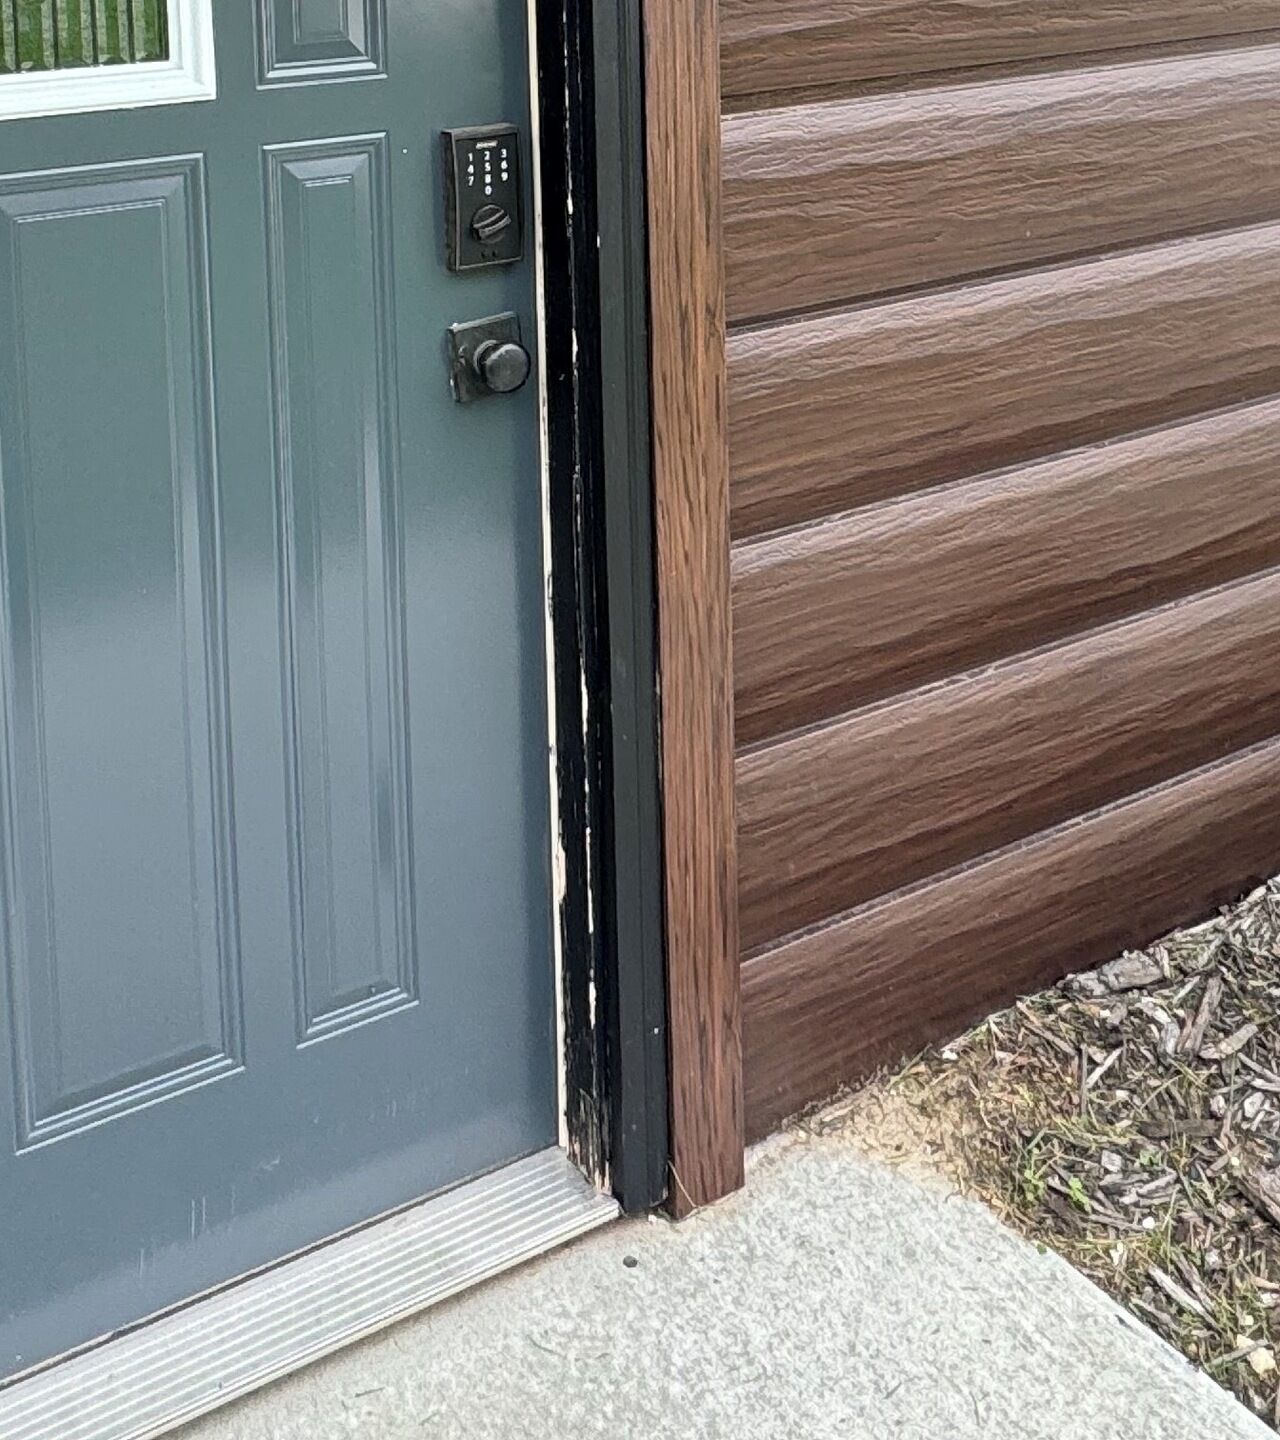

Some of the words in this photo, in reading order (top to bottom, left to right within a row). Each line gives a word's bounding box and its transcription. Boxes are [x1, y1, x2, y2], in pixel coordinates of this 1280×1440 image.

[468, 152, 473, 162] 1
[484, 150, 490, 161] 2
[501, 148, 507, 158] 3
[467, 164, 474, 174] 4
[484, 162, 491, 172] 5
[501, 160, 508, 170] 6
[468, 175, 474, 186] 7
[501, 171, 508, 181] 9
[484, 185, 492, 195] 0
